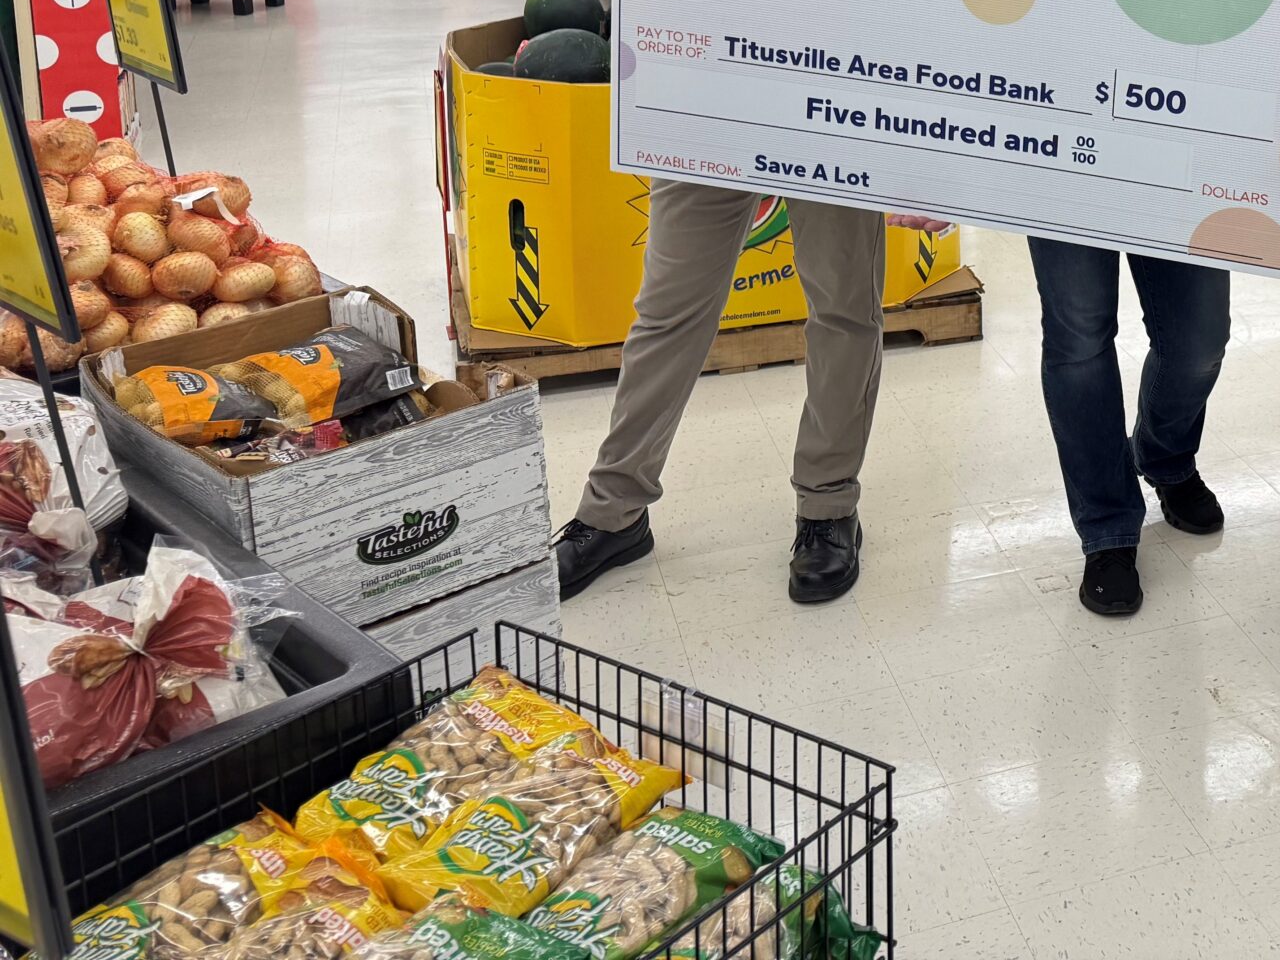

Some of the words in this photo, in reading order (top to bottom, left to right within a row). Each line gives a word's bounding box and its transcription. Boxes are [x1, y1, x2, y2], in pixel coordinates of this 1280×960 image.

[637, 26, 663, 39] PAY
[665, 30, 683, 42] TO
[687, 33, 711, 46] THE
[637, 40, 682, 56] ORDER
[686, 47, 706, 59] OF:
[724, 36, 840, 71] Titusville
[848, 55, 908, 82] Area
[917, 64, 980, 92] Food
[989, 75, 1054, 104] Bank
[1095, 81, 1109, 104] $
[1125, 84, 1186, 114] 500
[806, 97, 866, 127] Five
[875, 108, 996, 147] hundred
[1004, 135, 1058, 157] and
[1076, 136, 1095, 148] 00
[637, 151, 695, 170] PAYABLE
[700, 161, 742, 176] FROM:
[755, 155, 806, 177] Save
[812, 164, 828, 180] A
[835, 167, 869, 187] Lot
[1072, 152, 1096, 165] 100
[1202, 184, 1268, 205] DOLLARS
[359, 506, 456, 554] Tasteful
[374, 530, 445, 559] SELECTIONS
[361, 575, 380, 590] Find
[381, 567, 407, 581] recipe
[409, 551, 451, 573] inspiration
[453, 548, 462, 558] at
[634, 820, 712, 855] salted
